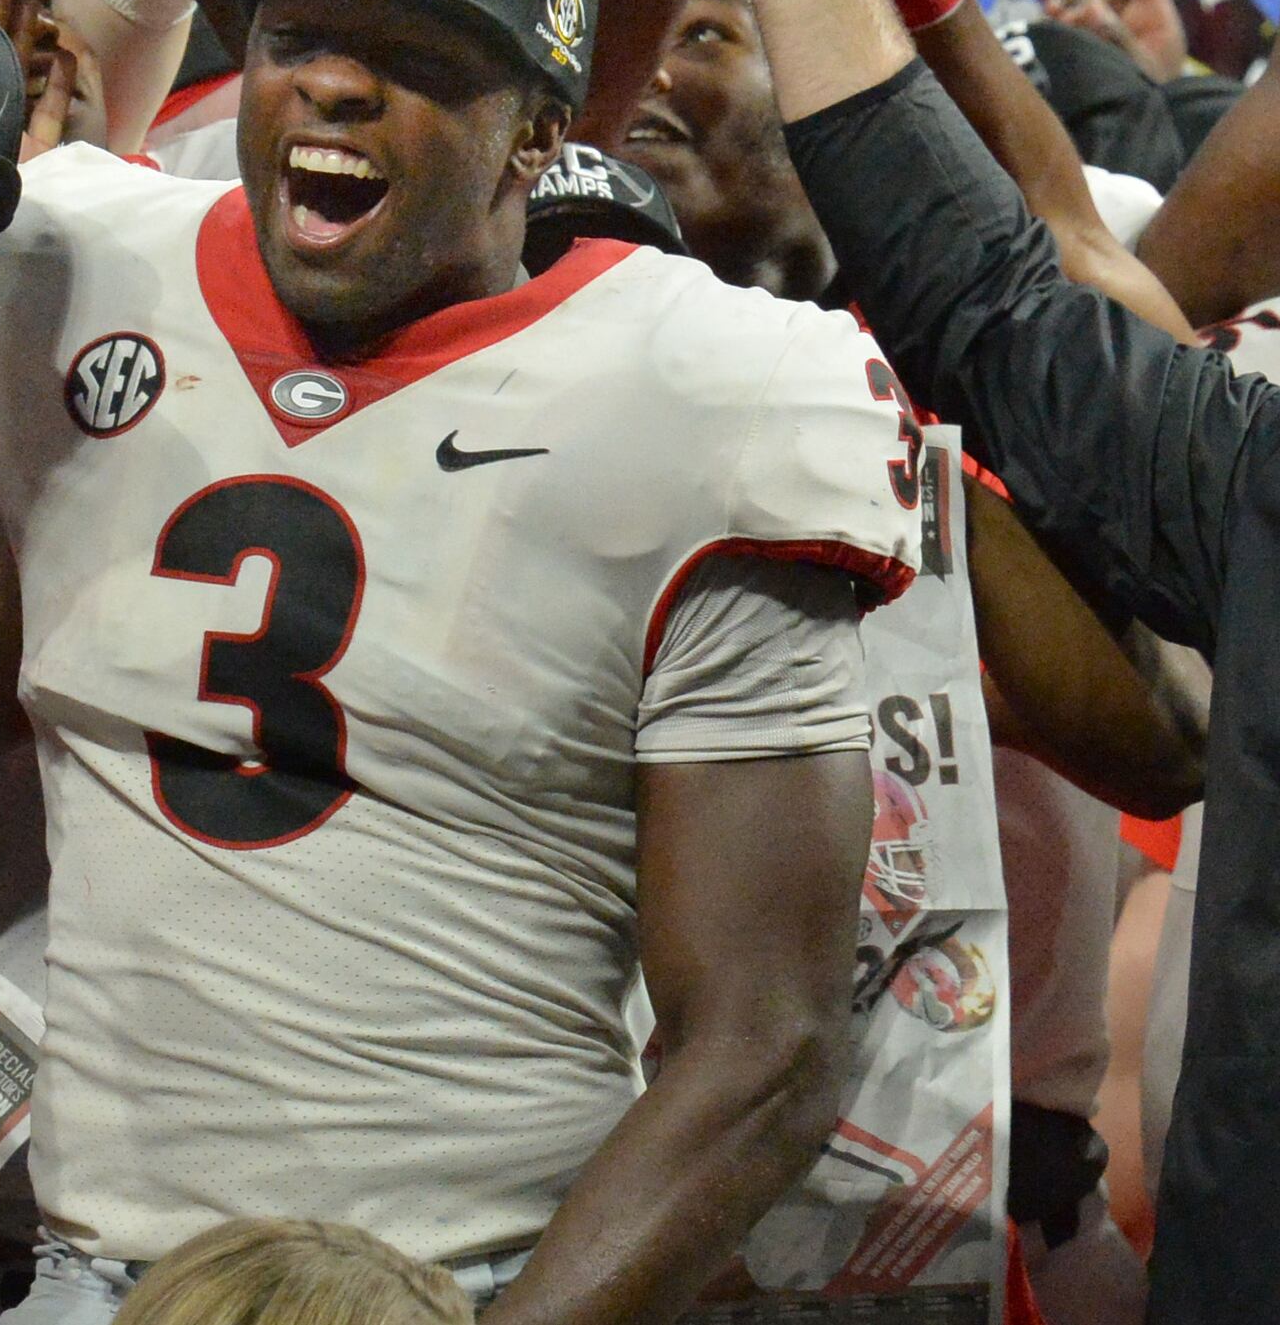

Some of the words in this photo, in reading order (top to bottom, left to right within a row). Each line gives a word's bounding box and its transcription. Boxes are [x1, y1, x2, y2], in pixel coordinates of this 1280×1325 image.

[530, 172, 614, 200] AMPS
[72, 338, 161, 431] SEC
[144, 474, 366, 850] 3
